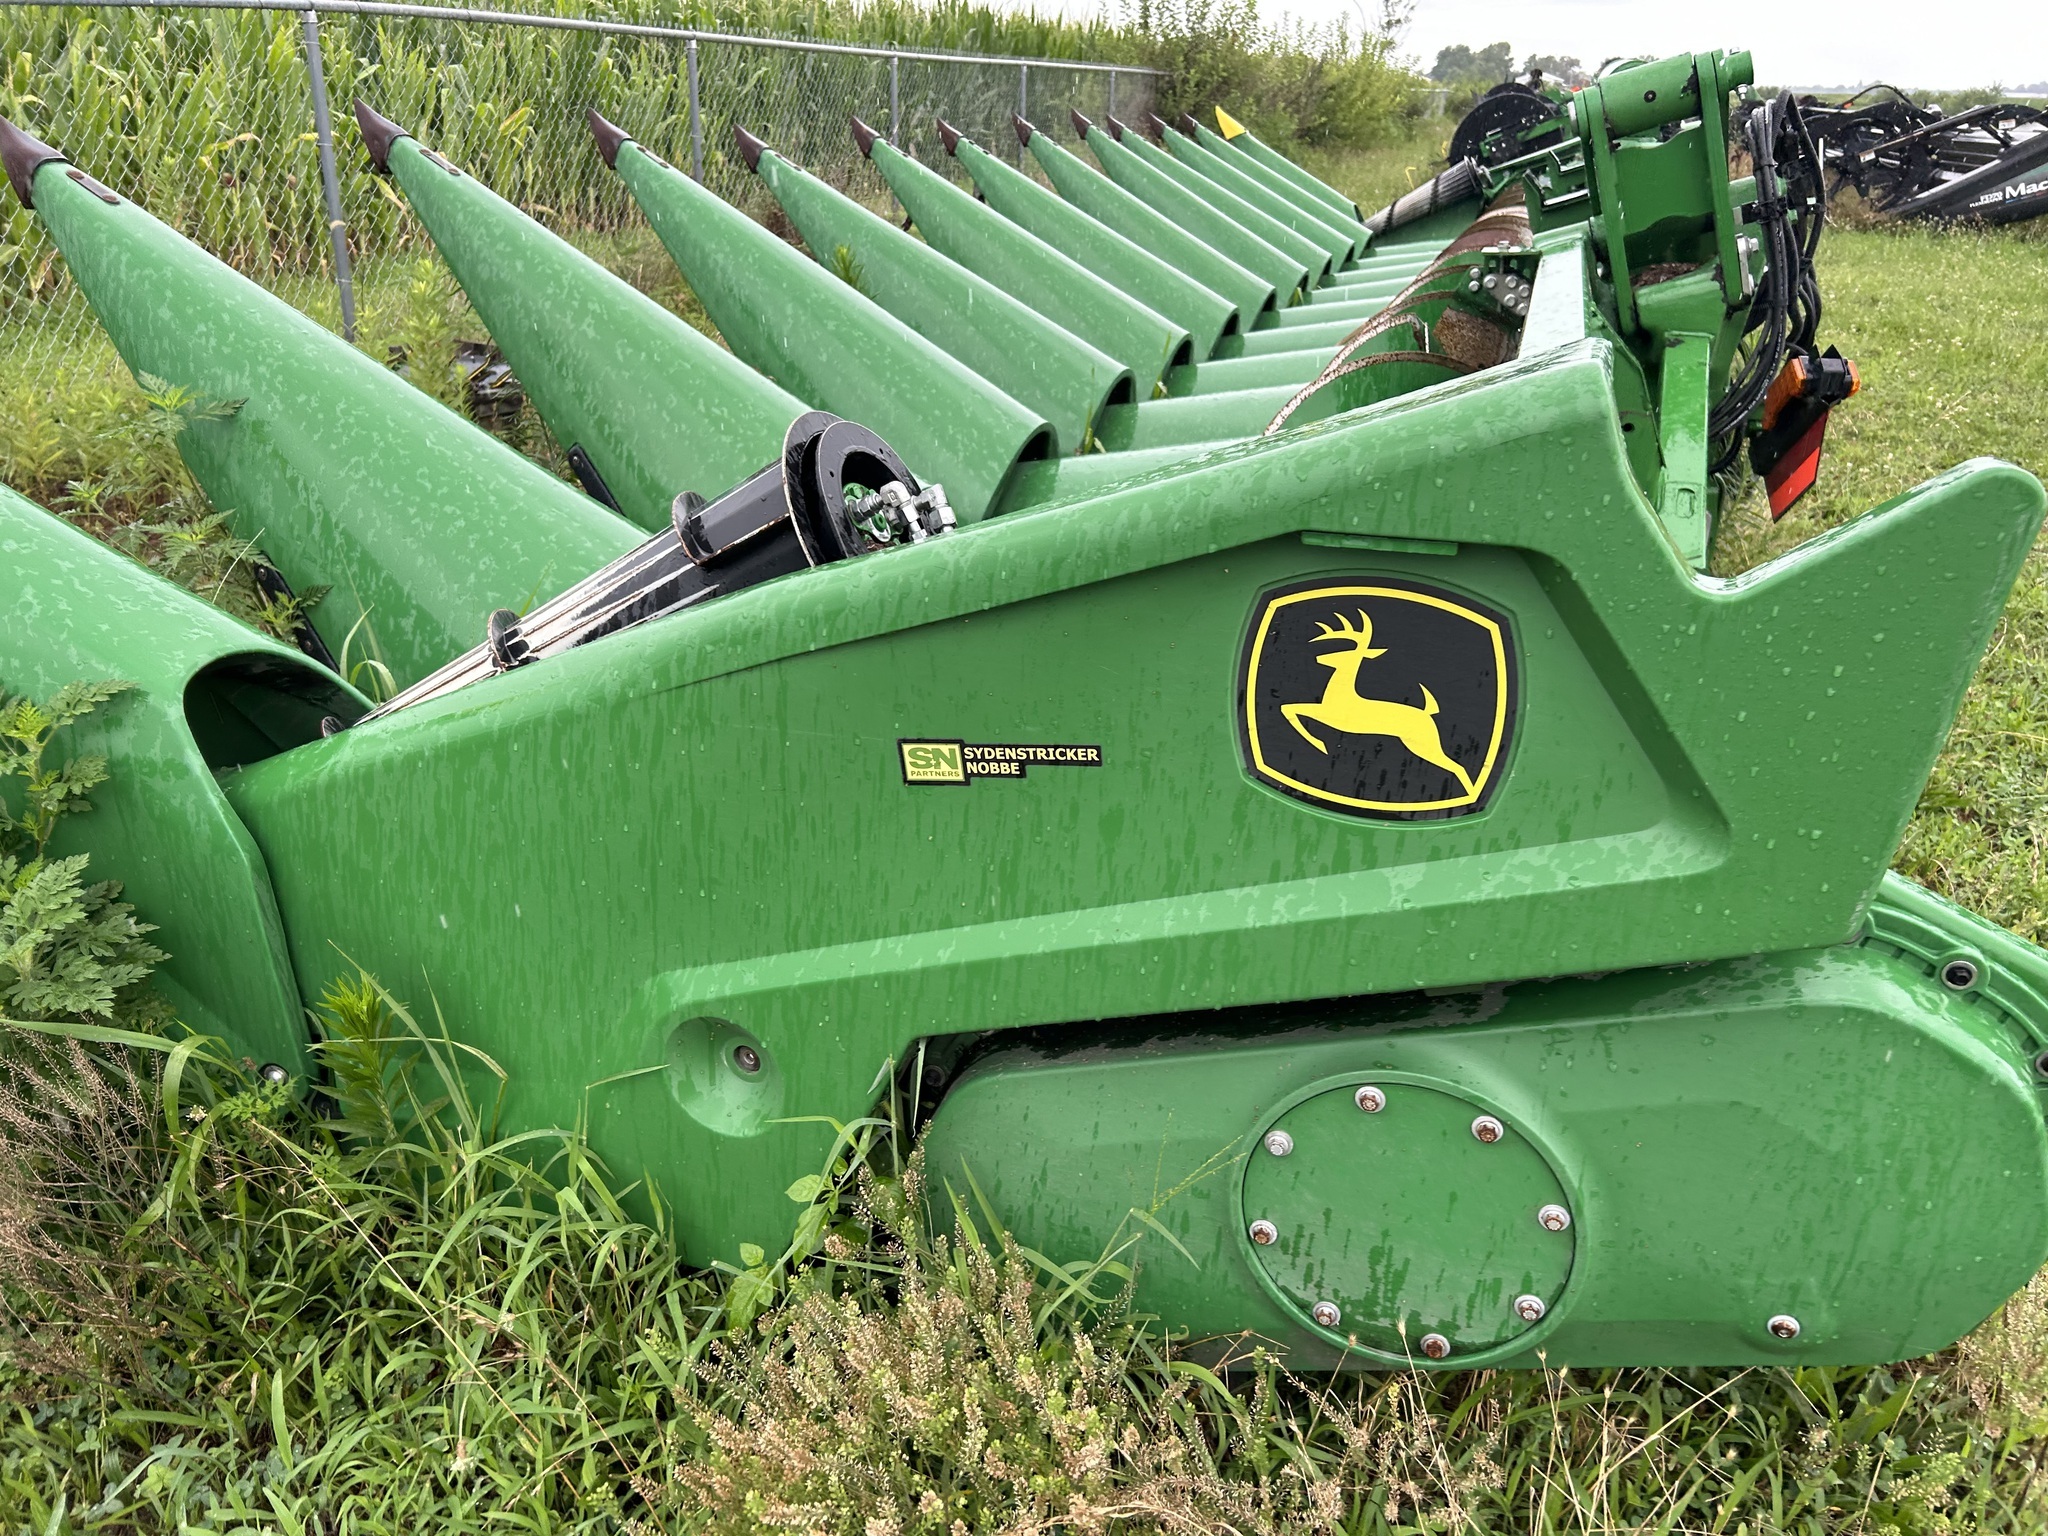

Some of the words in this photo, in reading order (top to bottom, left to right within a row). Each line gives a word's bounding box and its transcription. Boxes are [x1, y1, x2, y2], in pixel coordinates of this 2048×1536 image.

[964, 747, 1099, 760] SYDENSTRICKER
[910, 770, 960, 778] PARTNERS
[967, 762, 1020, 774] NOBBE
